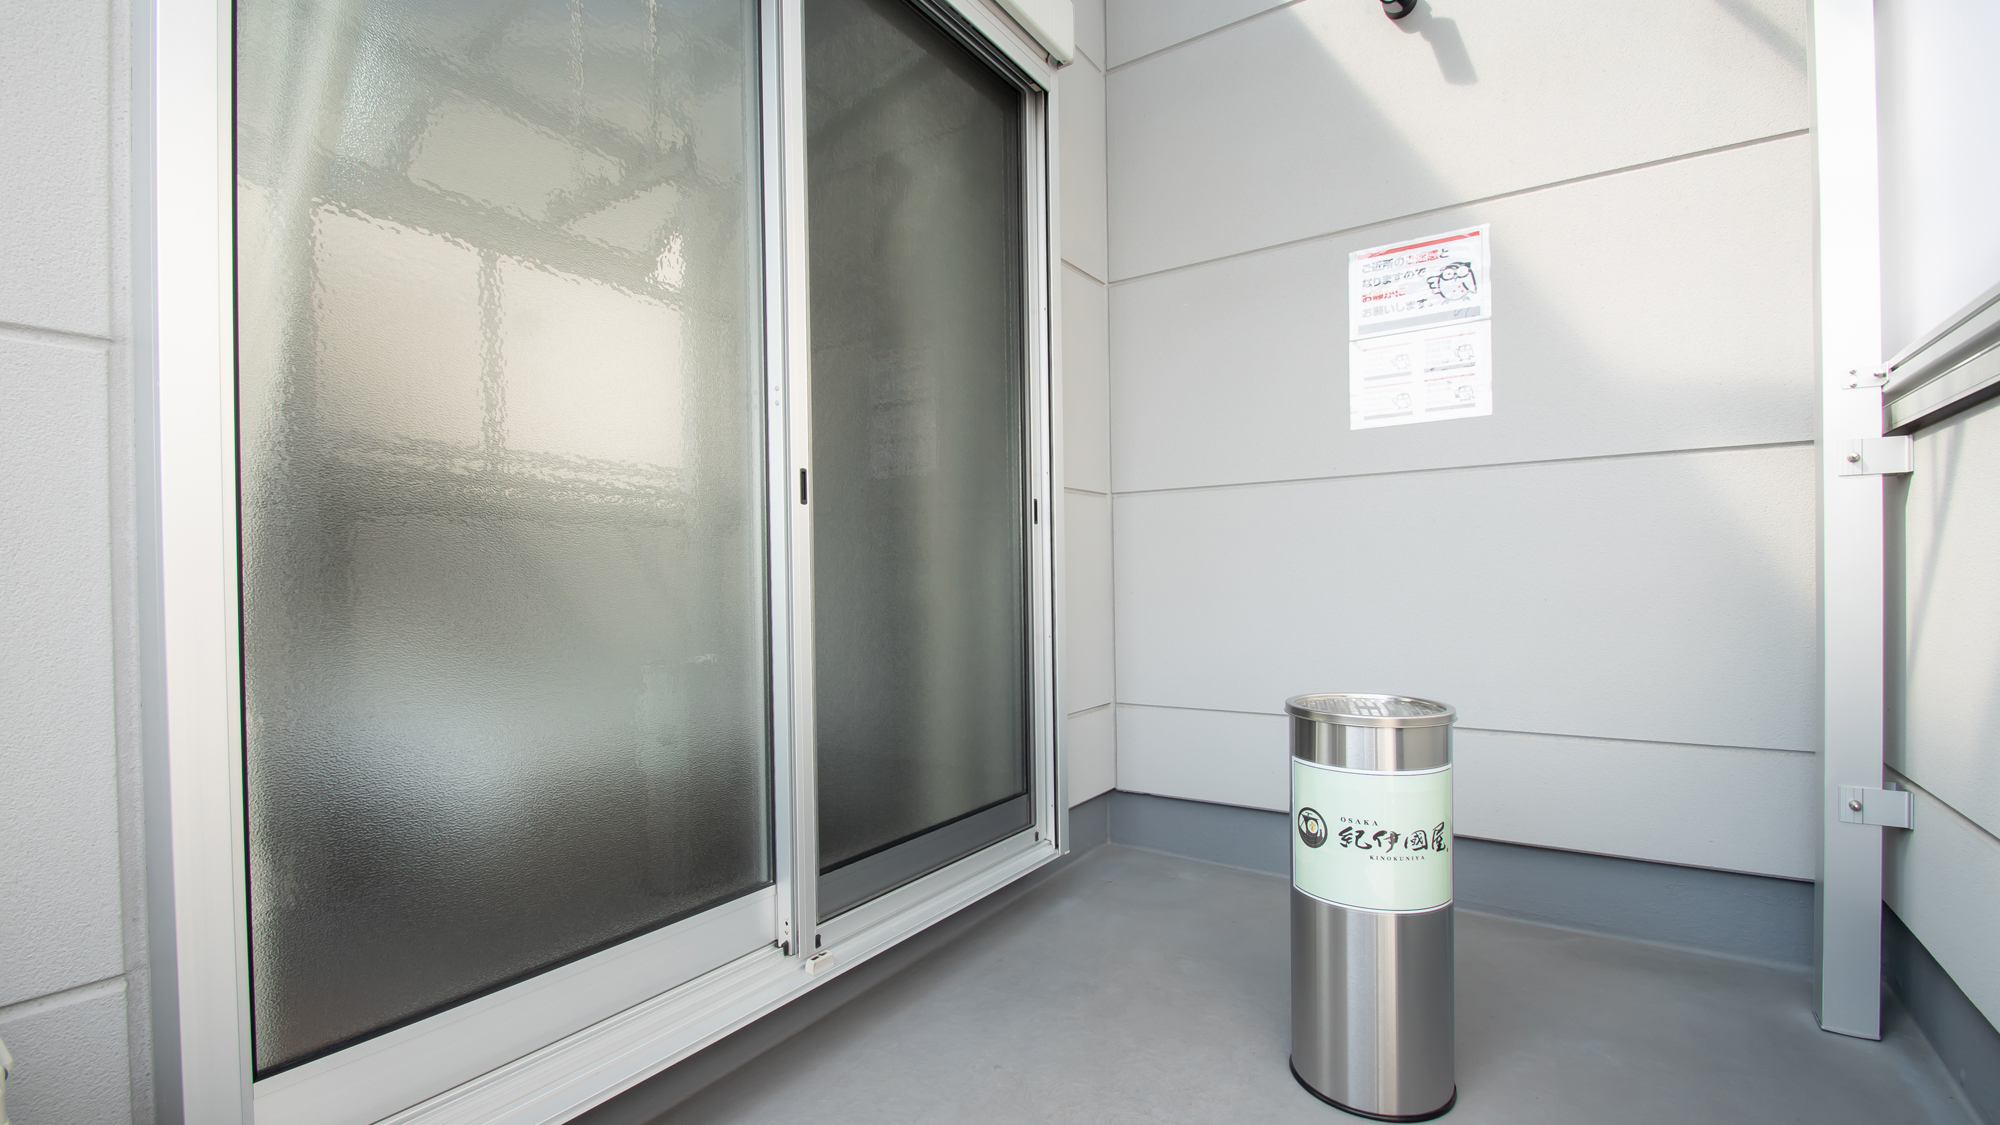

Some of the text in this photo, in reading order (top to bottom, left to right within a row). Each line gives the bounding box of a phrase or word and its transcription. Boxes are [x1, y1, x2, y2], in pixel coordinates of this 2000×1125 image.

[1362, 267, 1427, 288] なりますので
[1340, 816, 1379, 826] OSAKA
[1338, 821, 1446, 853] 紀伊國屋
